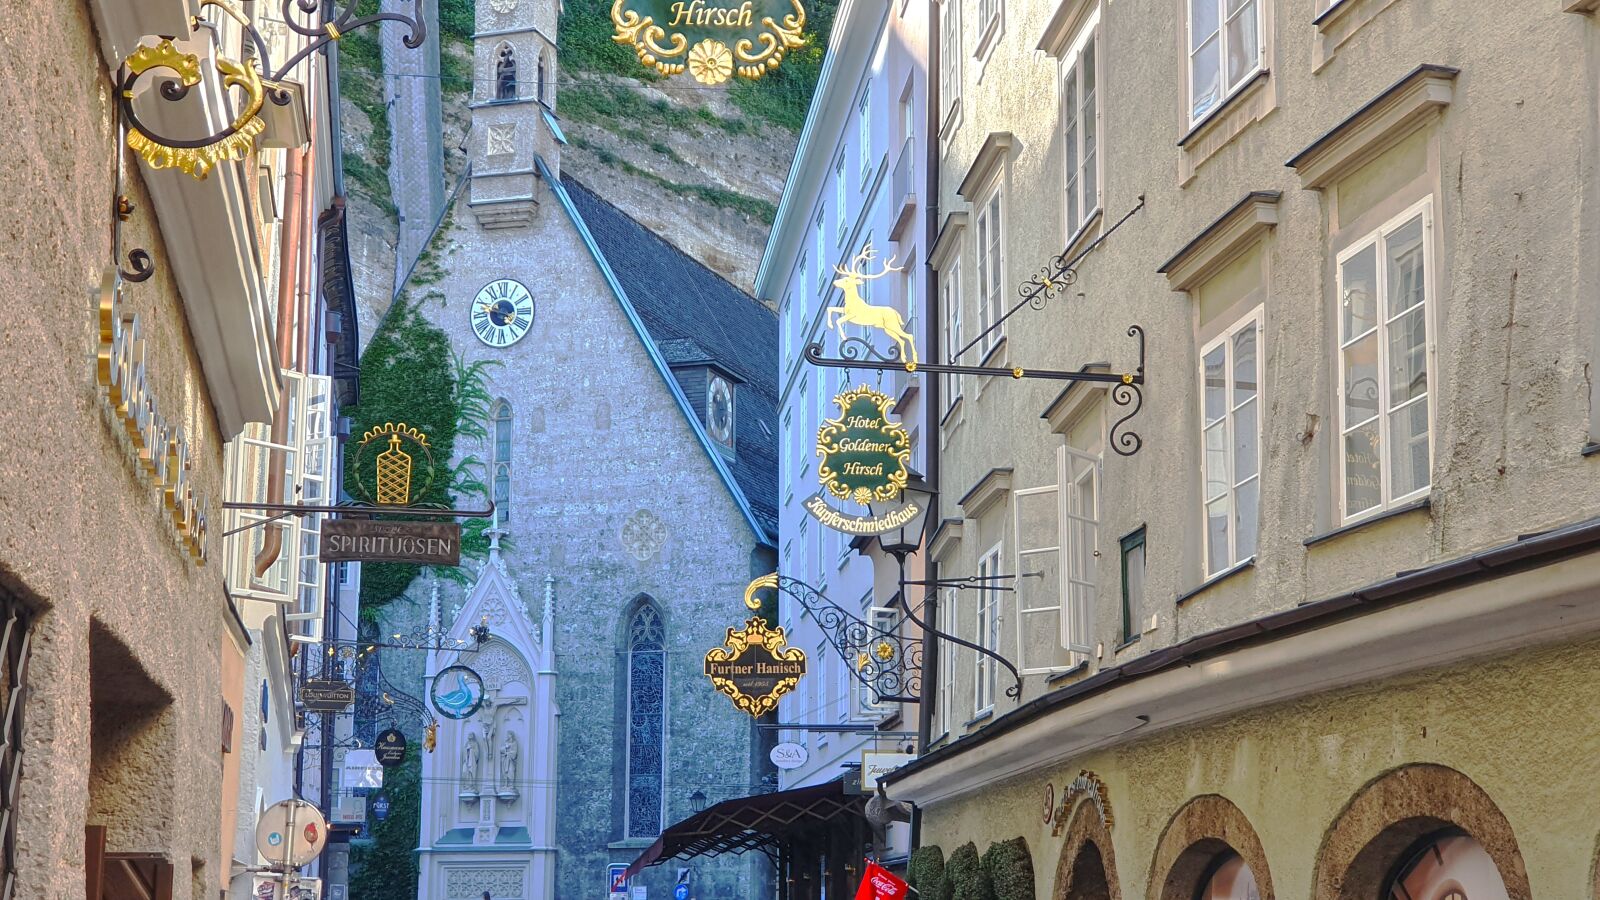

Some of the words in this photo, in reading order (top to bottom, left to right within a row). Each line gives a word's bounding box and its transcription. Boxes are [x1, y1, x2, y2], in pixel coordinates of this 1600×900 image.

[668, 0, 753, 27] Hirsch
[846, 415, 882, 429] Hotel
[839, 437, 891, 453] Goldener
[842, 462, 883, 476] Hirsch
[807, 496, 918, 532] Kupferschmiedhaus
[329, 534, 451, 555] SPIRITUOSEN
[710, 662, 753, 675] Furtner
[756, 662, 801, 674] Hanisch
[776, 748, 801, 759] S&A
